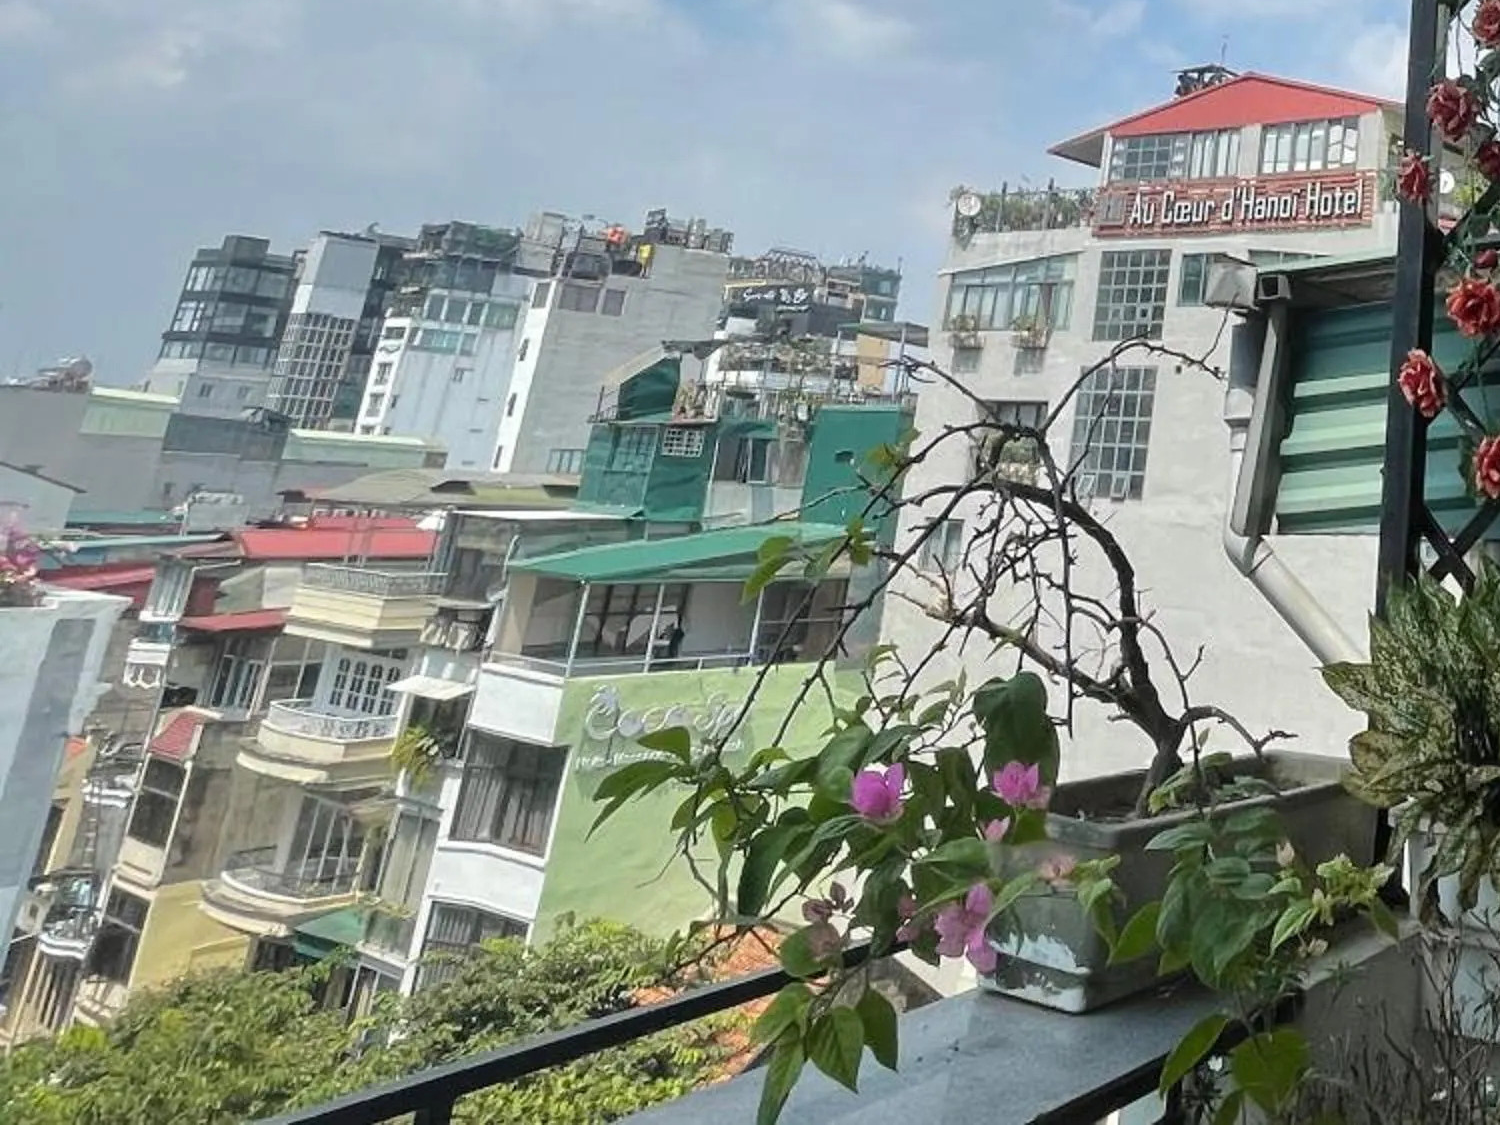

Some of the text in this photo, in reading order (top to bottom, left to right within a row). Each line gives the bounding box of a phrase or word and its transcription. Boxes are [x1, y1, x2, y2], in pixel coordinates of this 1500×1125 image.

[1129, 189, 1154, 225] Au
[1221, 185, 1301, 221] d'Hanoi
[1305, 178, 1364, 217] Hotel
